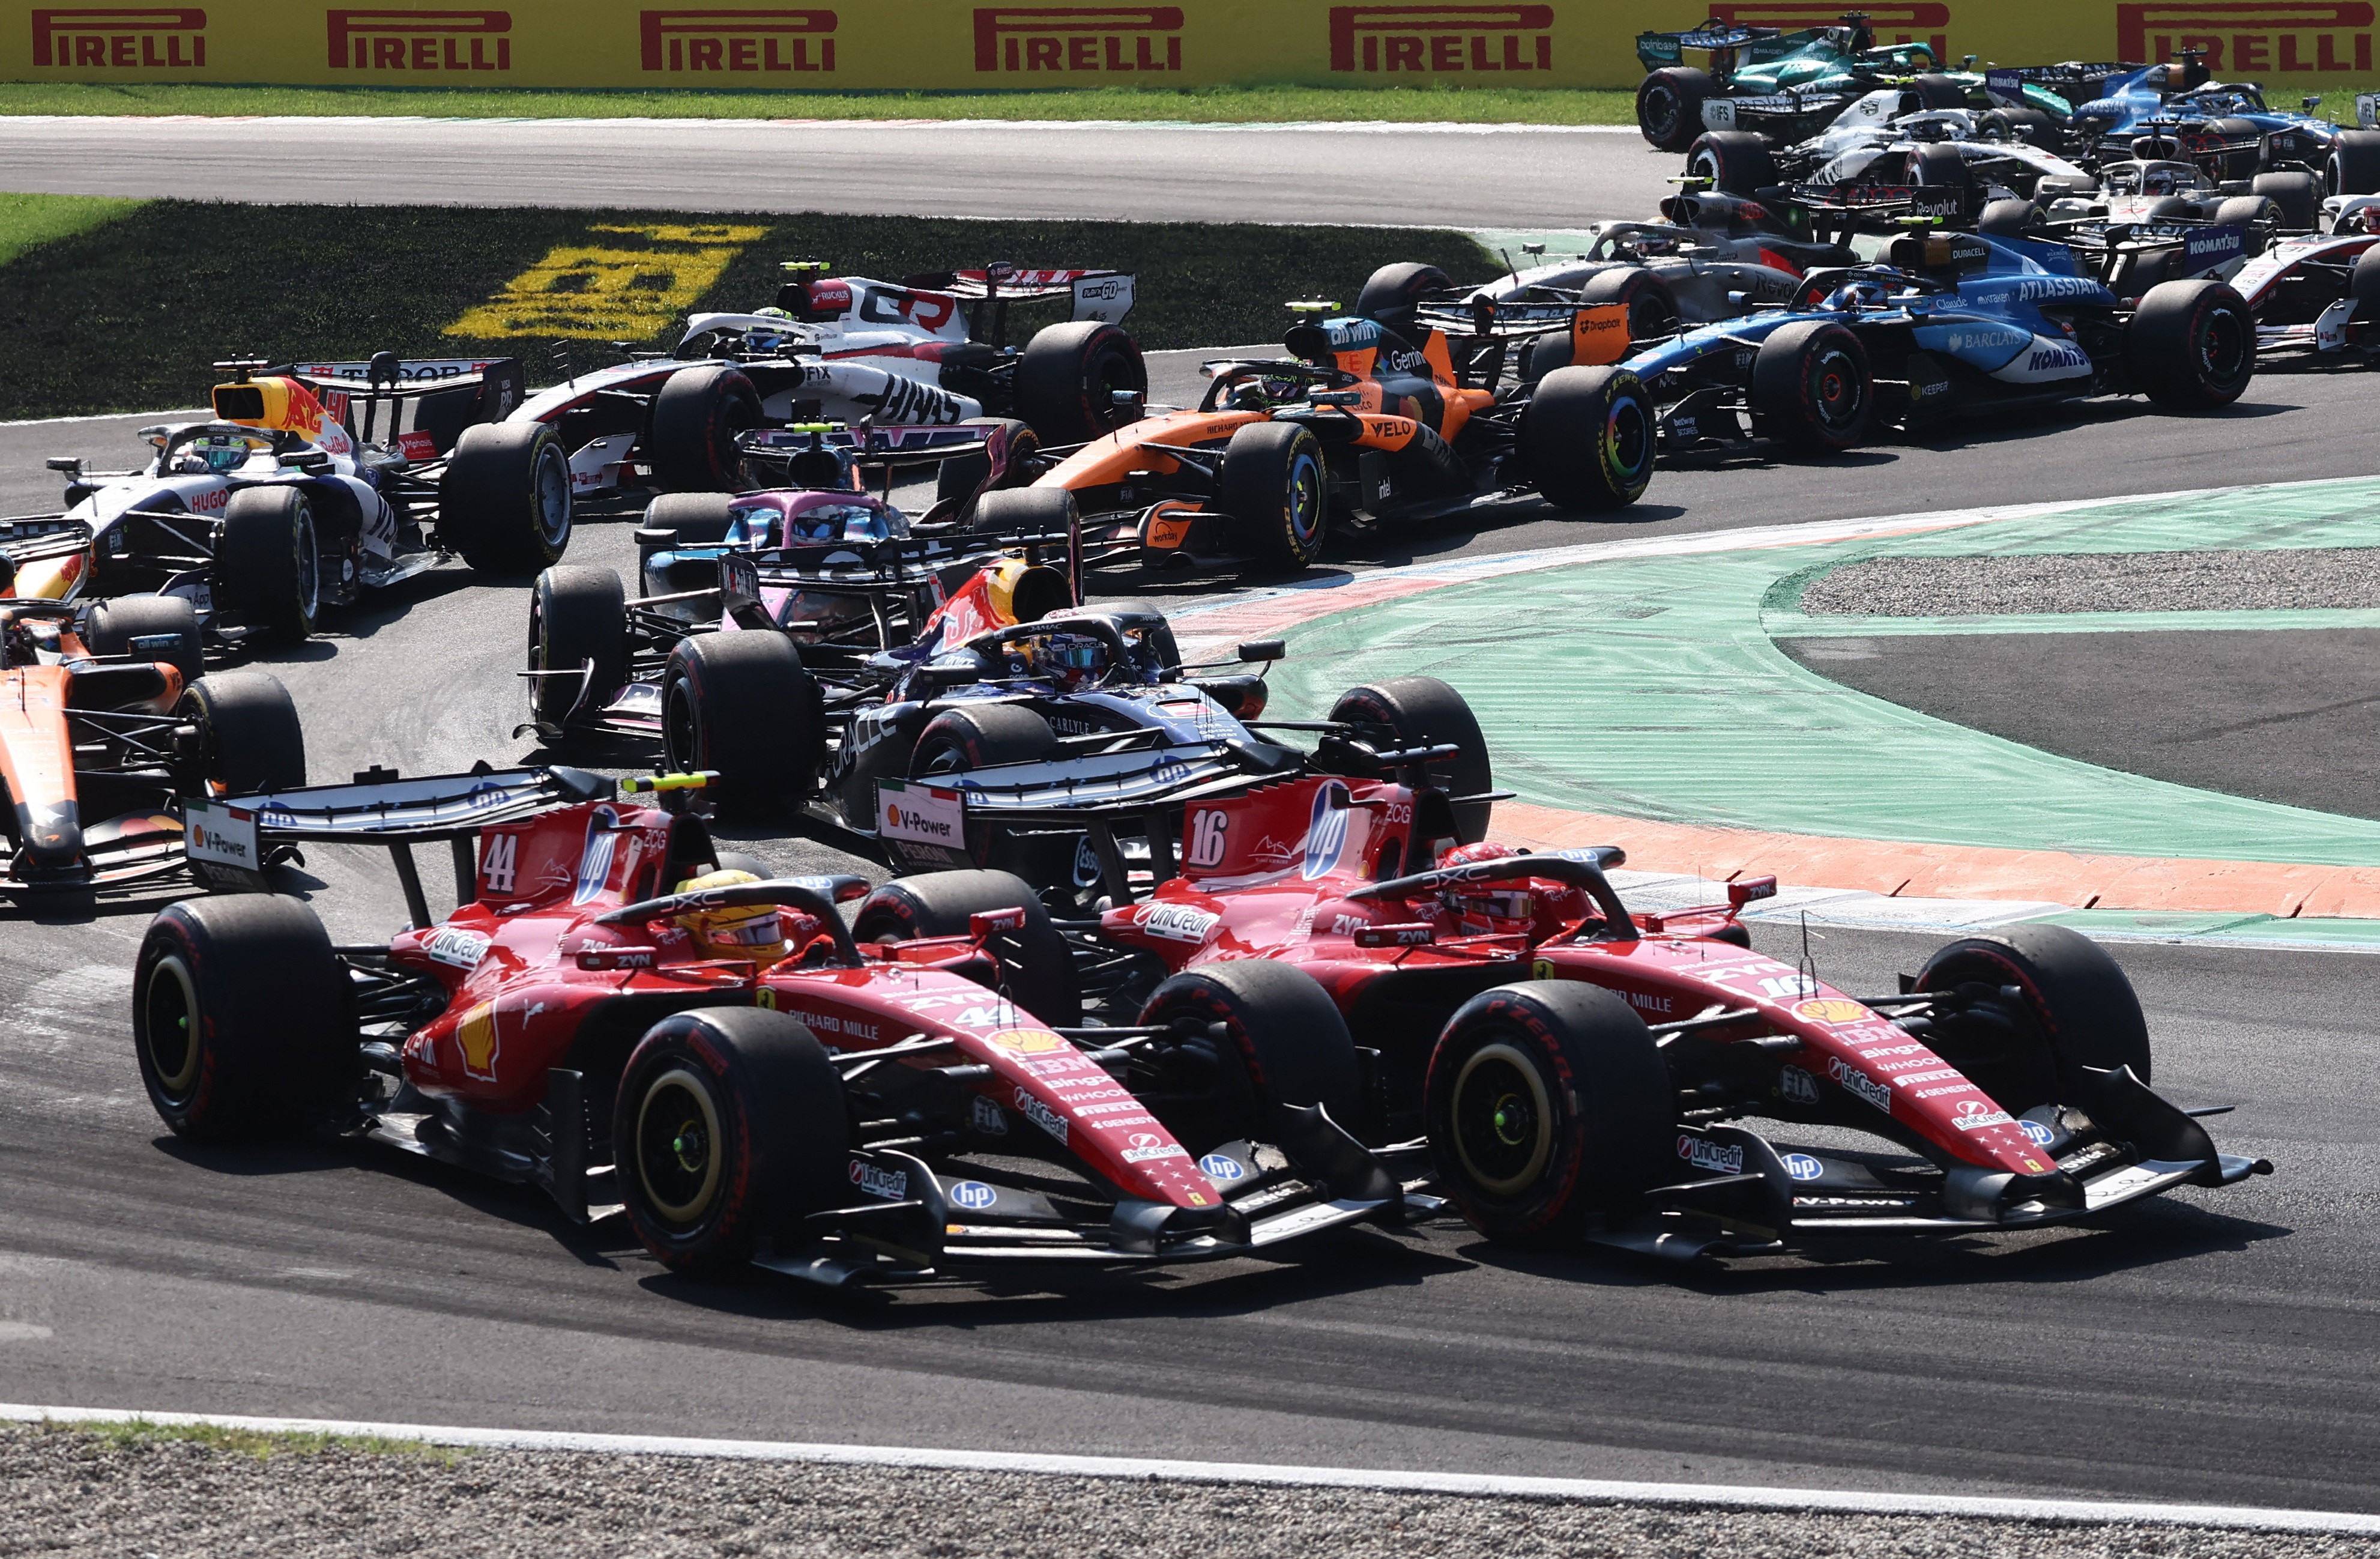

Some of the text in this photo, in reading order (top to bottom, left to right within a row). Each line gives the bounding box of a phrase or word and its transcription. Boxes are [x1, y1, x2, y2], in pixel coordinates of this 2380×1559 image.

[32, 8, 207, 67] PIRELLI
[327, 9, 512, 70] PIRELLI
[639, 10, 838, 71] PIRELLI
[973, 6, 1185, 71] PIRELLI
[1329, 5, 1554, 71] PIRELLI
[1640, 40, 1678, 51] coinbase
[2117, 1, 2375, 71] PIRELLI
[1953, 247, 1986, 259] DURACELL
[2190, 234, 2240, 255] KOMATSU
[821, 290, 849, 300] RUCKUS
[1102, 282, 1117, 299] GO
[2019, 277, 2101, 301] ATLASSIAN
[1936, 296, 1968, 310] Claude
[1352, 323, 1377, 343] win
[1590, 318, 1620, 332] Dropbox
[1965, 331, 2021, 350] BARCLAYS
[2028, 344, 2091, 372] KOMATSU
[806, 366, 831, 380] FIX
[501, 380, 511, 389] VISA
[1921, 380, 1949, 396] KEEPER
[1207, 422, 1238, 434] RICHARD
[1371, 420, 1411, 438] VELO
[1673, 416, 1696, 427] betway
[1121, 488, 1134, 501] FIA
[1378, 476, 1391, 500] intel
[192, 489, 228, 513] HUGO
[1152, 531, 1177, 543] workday
[1028, 623, 1062, 632] DAMAC
[154, 638, 169, 649] win
[1067, 642, 1104, 650] ORACLE
[1050, 716, 1090, 734] CARLYLE
[899, 810, 951, 837] V-Power
[204, 834, 246, 858] V-Power
[1189, 808, 1228, 868] 16
[482, 833, 518, 893] 44
[898, 841, 953, 864] PERONI
[1568, 849, 1592, 862] hp
[1749, 885, 1771, 900] ZYN
[991, 916, 1015, 931] ZYN
[1150, 904, 1215, 933] UniCredit
[434, 928, 488, 960] UniCredit
[1397, 930, 1430, 943] ZYN
[617, 954, 651, 968] ZYN
[1695, 961, 1799, 982] ZYN
[1757, 974, 1819, 998] 16
[901, 991, 1006, 1012] ZYN
[1632, 993, 1673, 1013] MILLE
[789, 1010, 879, 1040] RICHARD MILLE
[953, 1004, 1022, 1028] 44
[1486, 999, 1573, 1080] P ZERO
[1829, 1023, 1910, 1046] IBM
[1859, 1043, 1928, 1059] BingX
[1025, 1056, 1100, 1077] IBM
[1045, 1074, 1116, 1089] BingX
[1781, 1071, 1817, 1101] FIA
[1841, 1064, 1890, 1107] UniCredit
[974, 1103, 1007, 1131] FIA
[1025, 1092, 1069, 1136] UniCredit
[1955, 1111, 2013, 1128] UniCredit
[1123, 1144, 1188, 1161] UniCredit
[1691, 1142, 1743, 1169] UniCredit
[860, 1163, 907, 1191] UniCredit
[1207, 1154, 1236, 1179] hp
[1787, 1154, 1815, 1179] hp
[960, 1181, 987, 1208] hp
